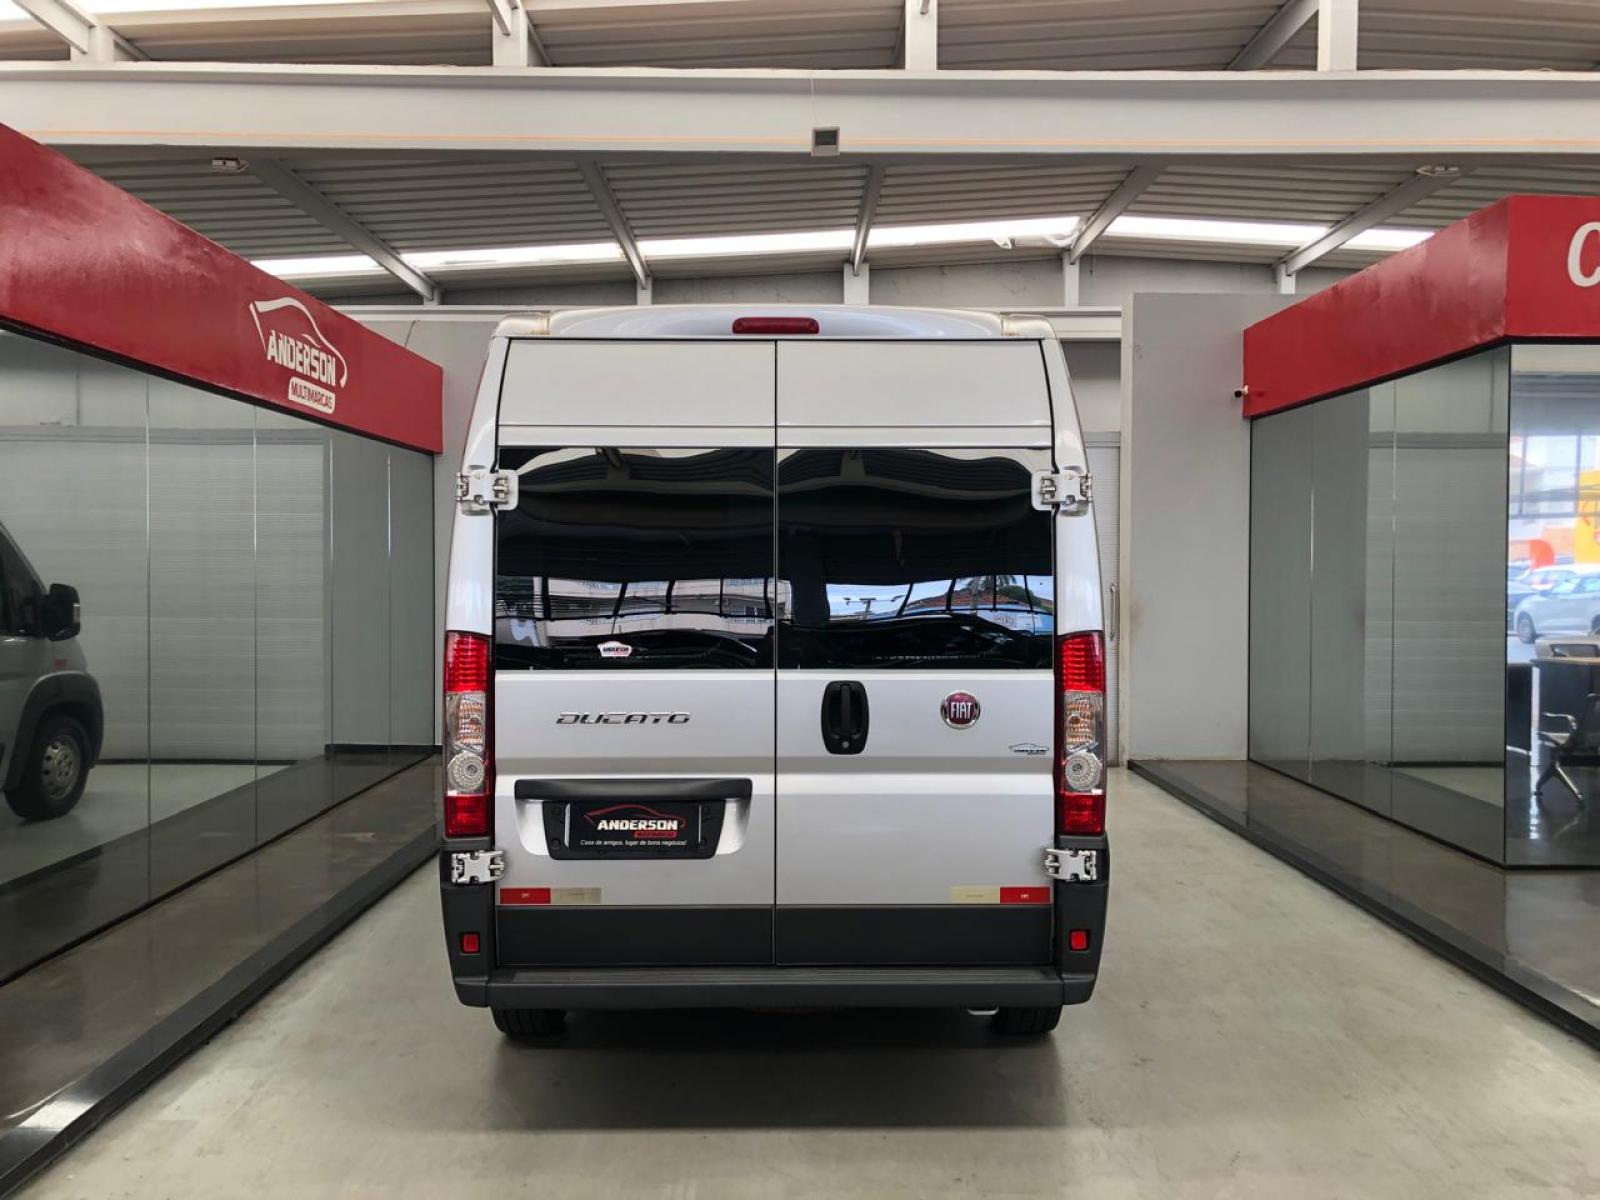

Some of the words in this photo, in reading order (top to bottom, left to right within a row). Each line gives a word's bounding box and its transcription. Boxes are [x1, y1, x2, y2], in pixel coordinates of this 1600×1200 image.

[267, 329, 336, 387] ANDERSON
[291, 380, 333, 409] MULTIMARCAS
[556, 711, 690, 724] DUCATO
[950, 701, 973, 719] FIAT
[597, 819, 678, 830] ANDERSON
